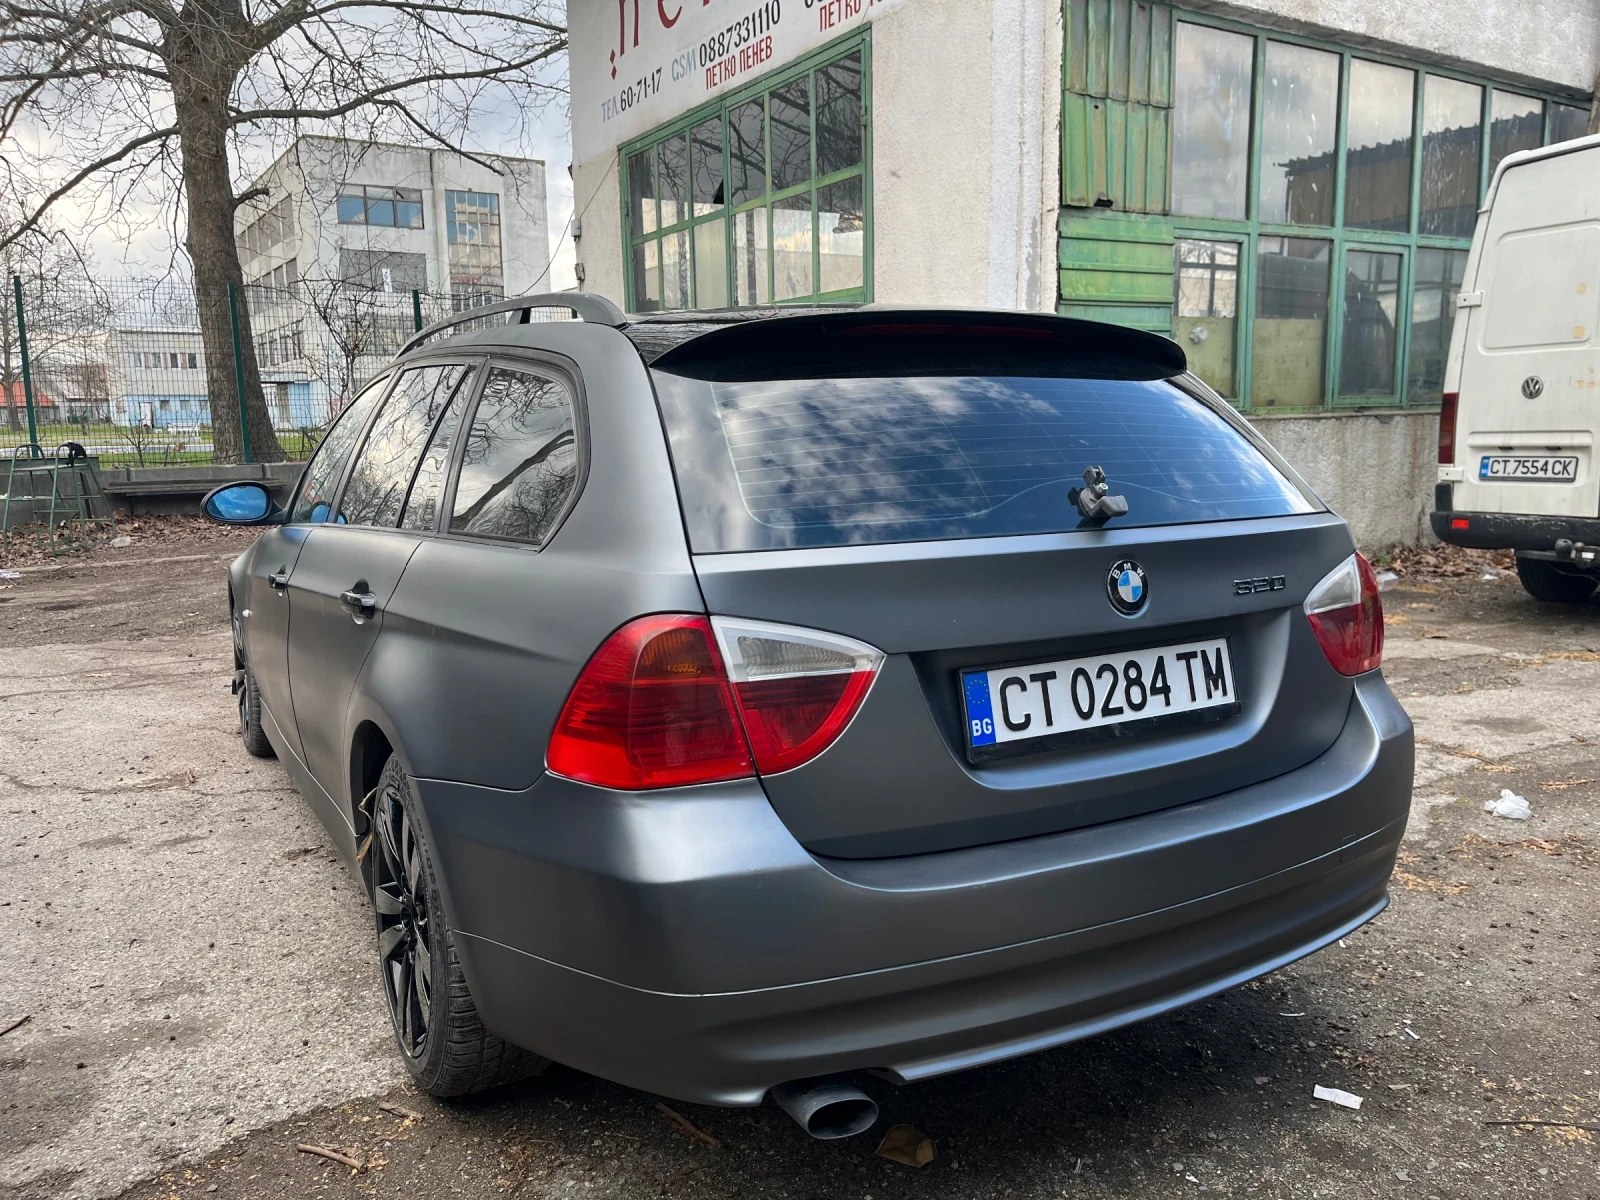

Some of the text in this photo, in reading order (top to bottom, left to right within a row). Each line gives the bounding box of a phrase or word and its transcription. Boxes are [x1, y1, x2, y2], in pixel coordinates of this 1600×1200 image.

[671, 47, 697, 82] GSM
[699, 0, 781, 68] 0887331110
[705, 35, 773, 91] ПЕТКО ПЕНЕВ
[1111, 562, 1145, 580] BMW
[999, 646, 1229, 732] CT 0284 TM
[971, 717, 993, 737] BG
